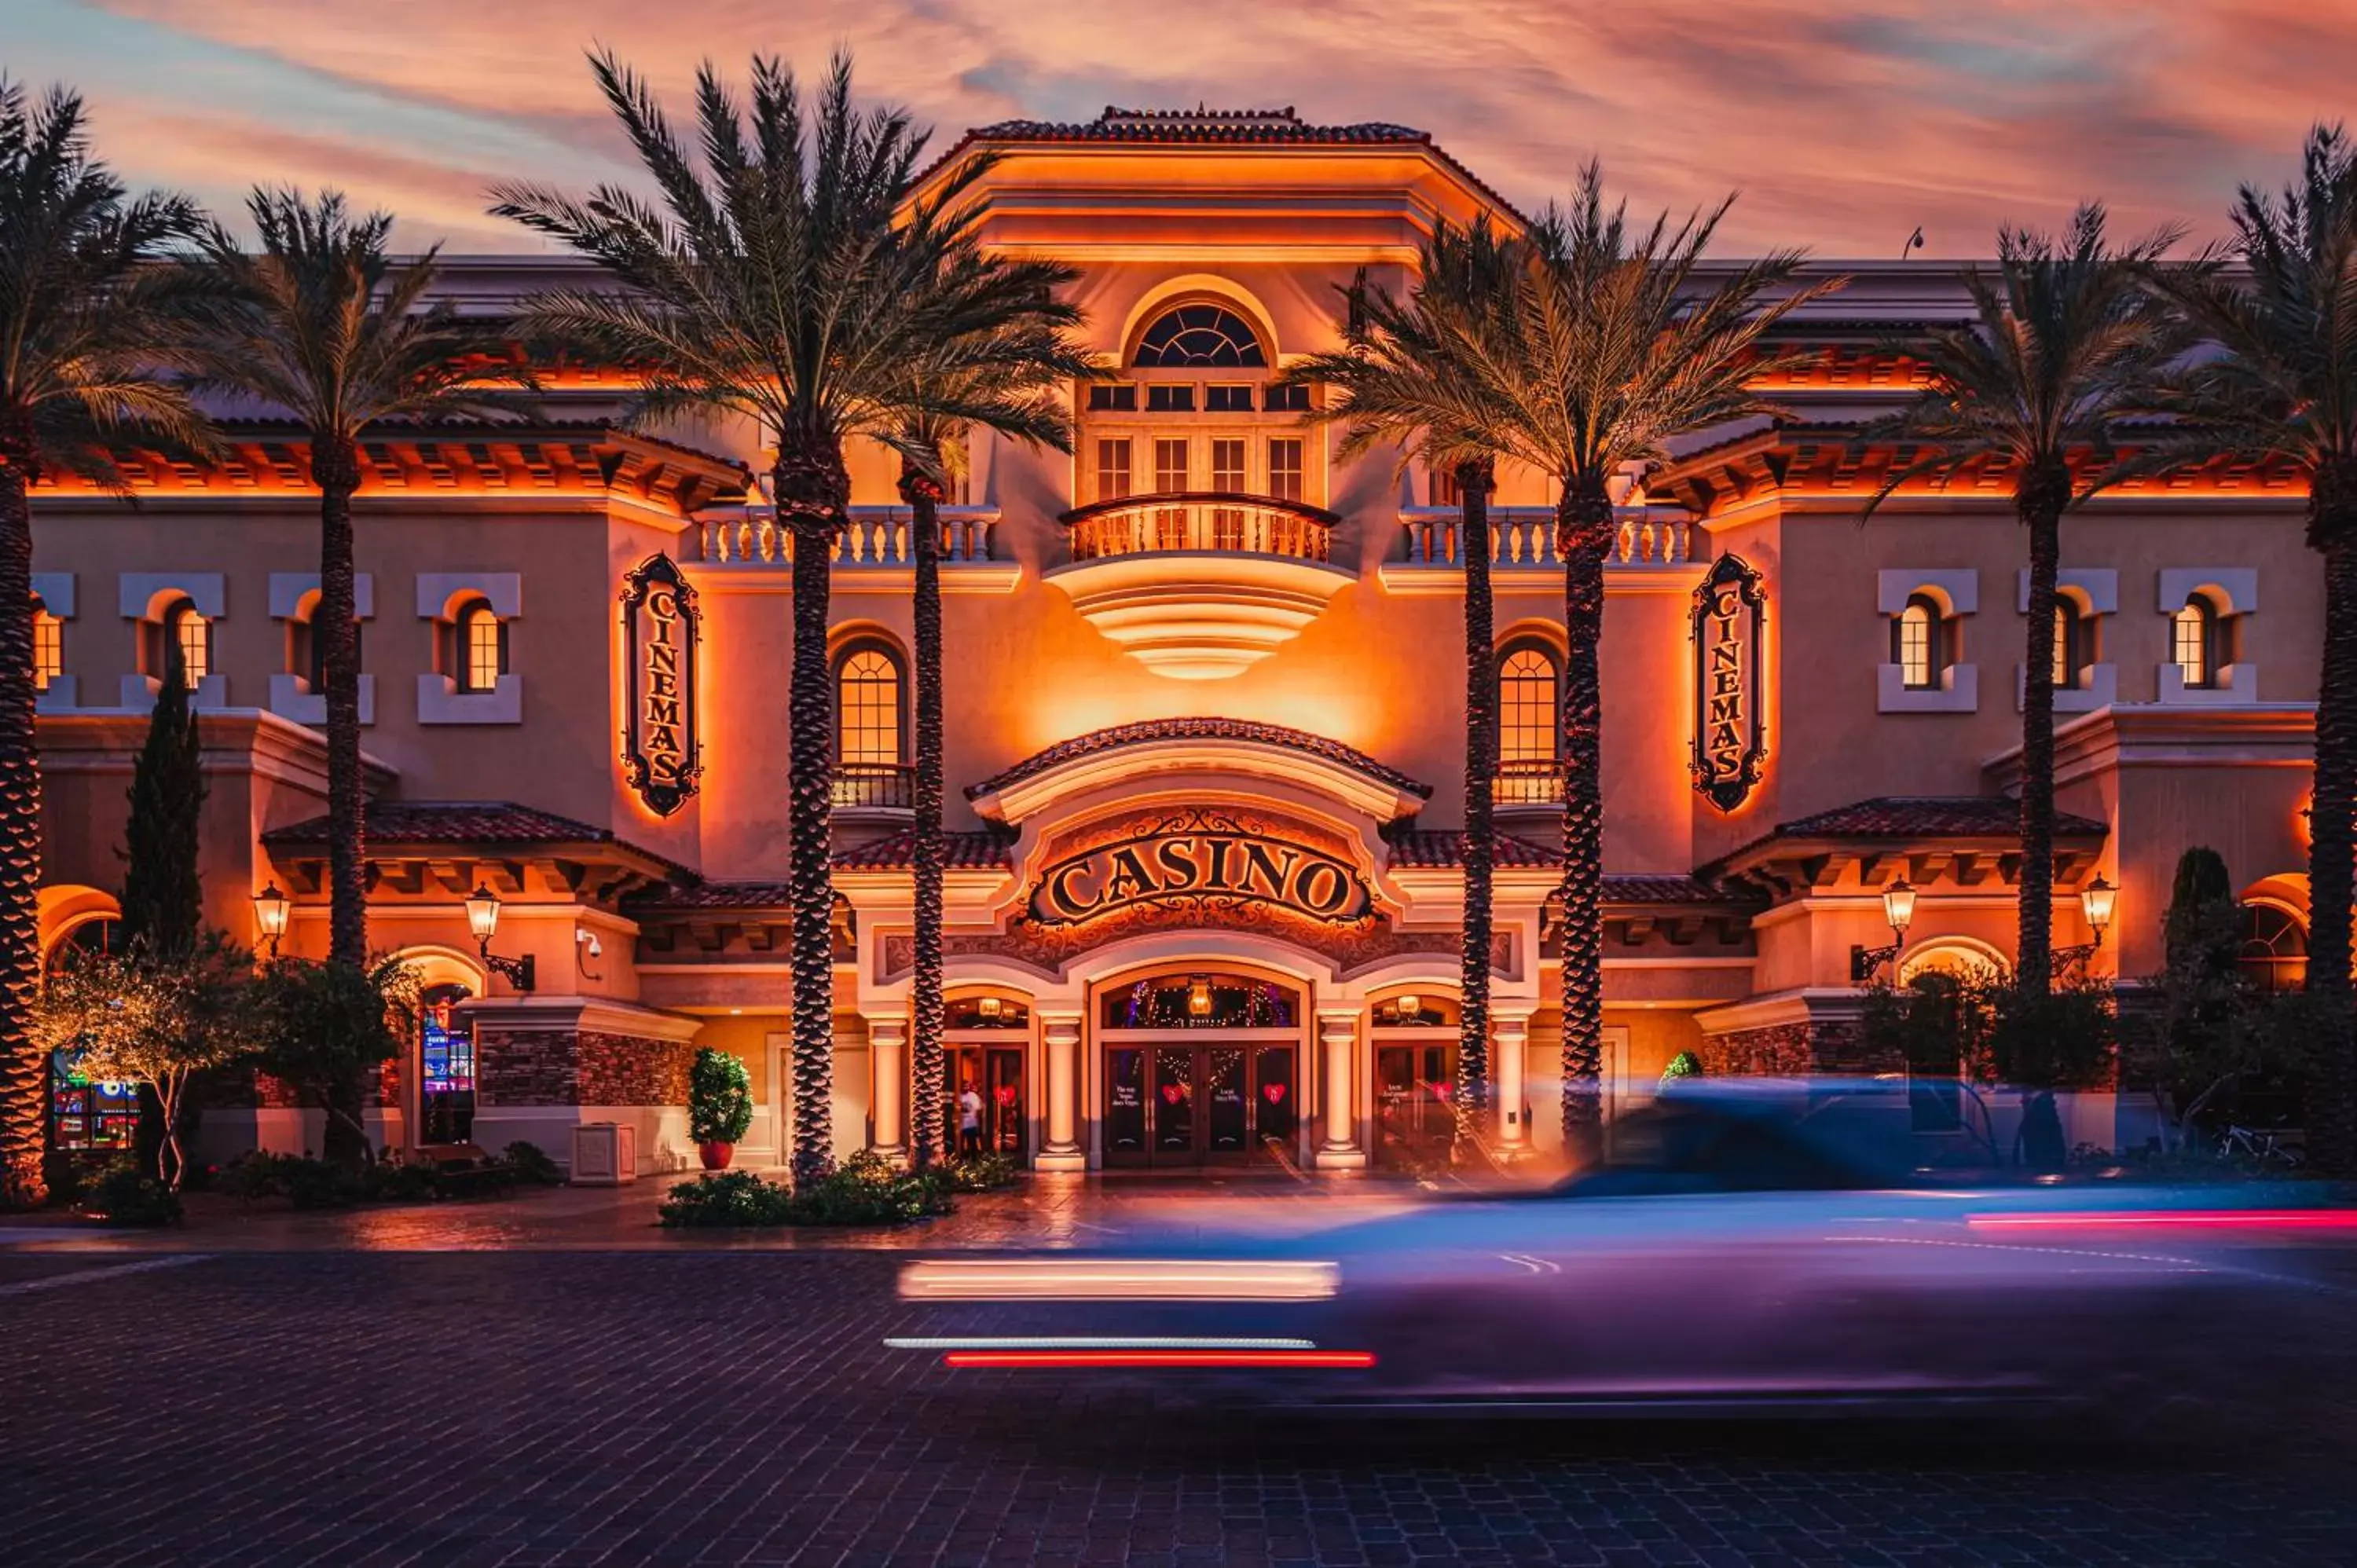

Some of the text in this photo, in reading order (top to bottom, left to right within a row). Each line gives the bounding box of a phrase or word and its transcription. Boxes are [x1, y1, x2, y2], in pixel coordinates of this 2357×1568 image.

[647, 592, 680, 779] CINEMAS
[1710, 591, 1742, 775] CINEMAS
[1053, 837, 1348, 914] CASINO
